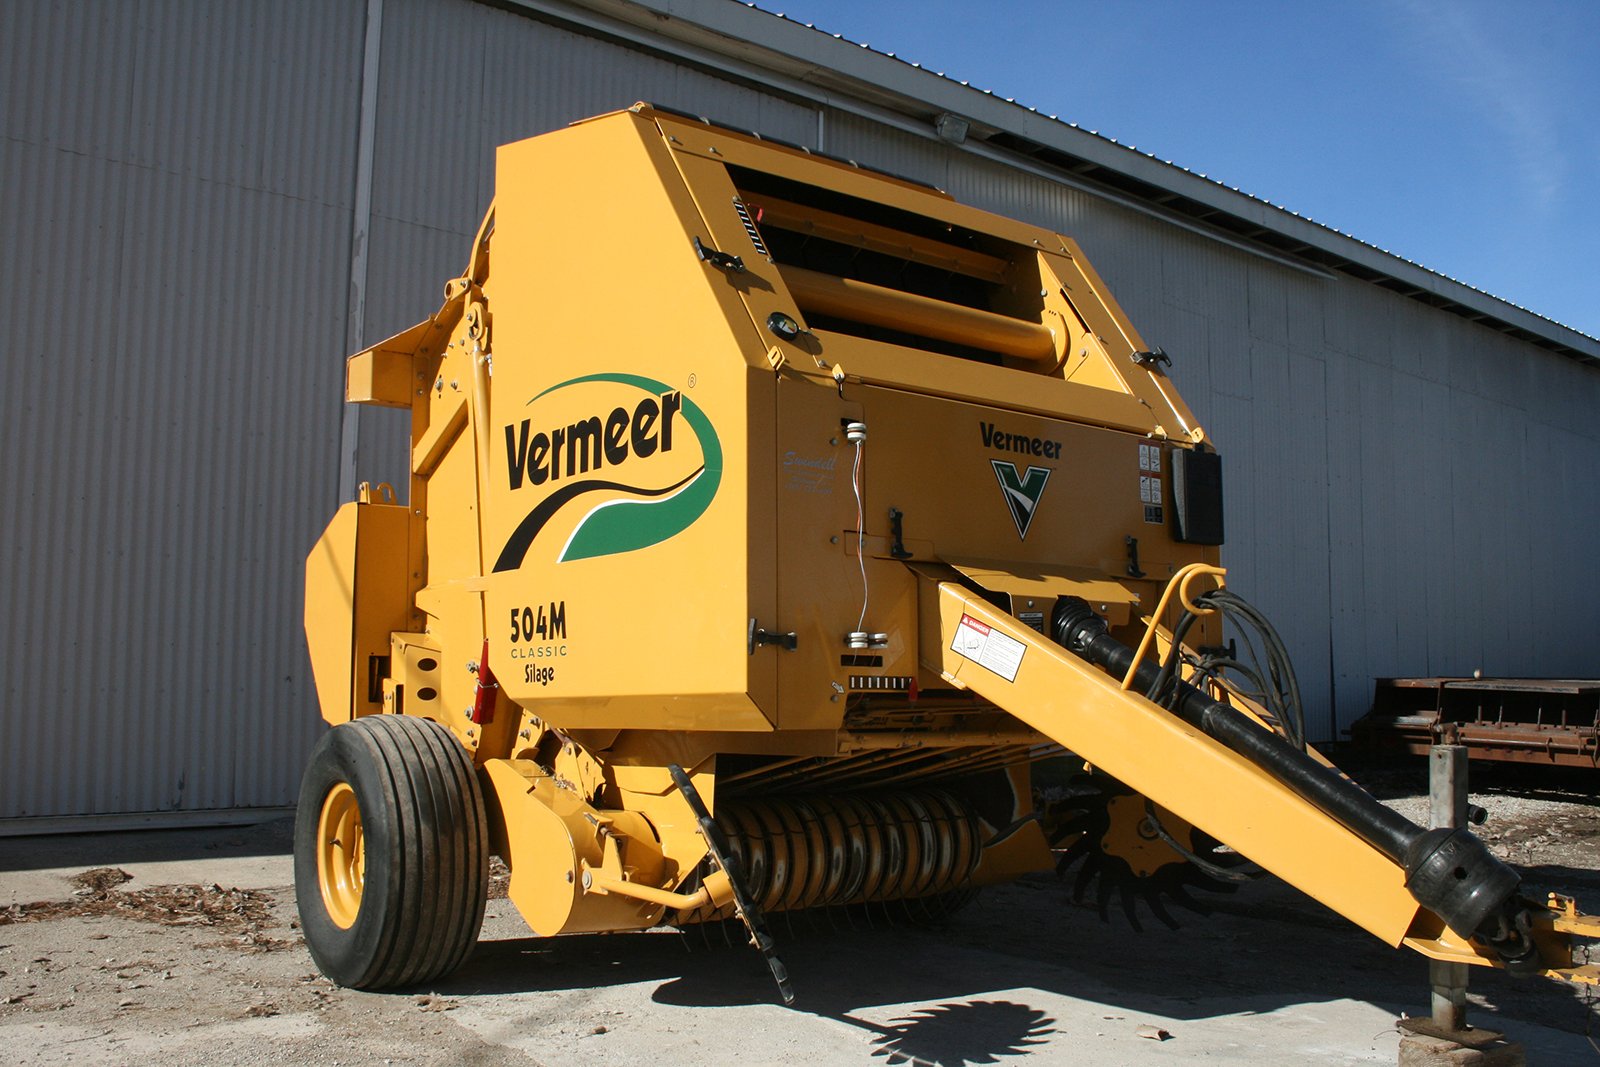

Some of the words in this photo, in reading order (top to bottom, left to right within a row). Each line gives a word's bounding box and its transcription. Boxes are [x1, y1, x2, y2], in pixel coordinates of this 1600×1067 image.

[504, 391, 681, 491] Vermeer
[980, 421, 1062, 460] Vermeer
[511, 600, 567, 643] 504M
[968, 620, 990, 635] DANGER
[511, 645, 567, 659] CLASSIC
[525, 663, 555, 686] Silage
